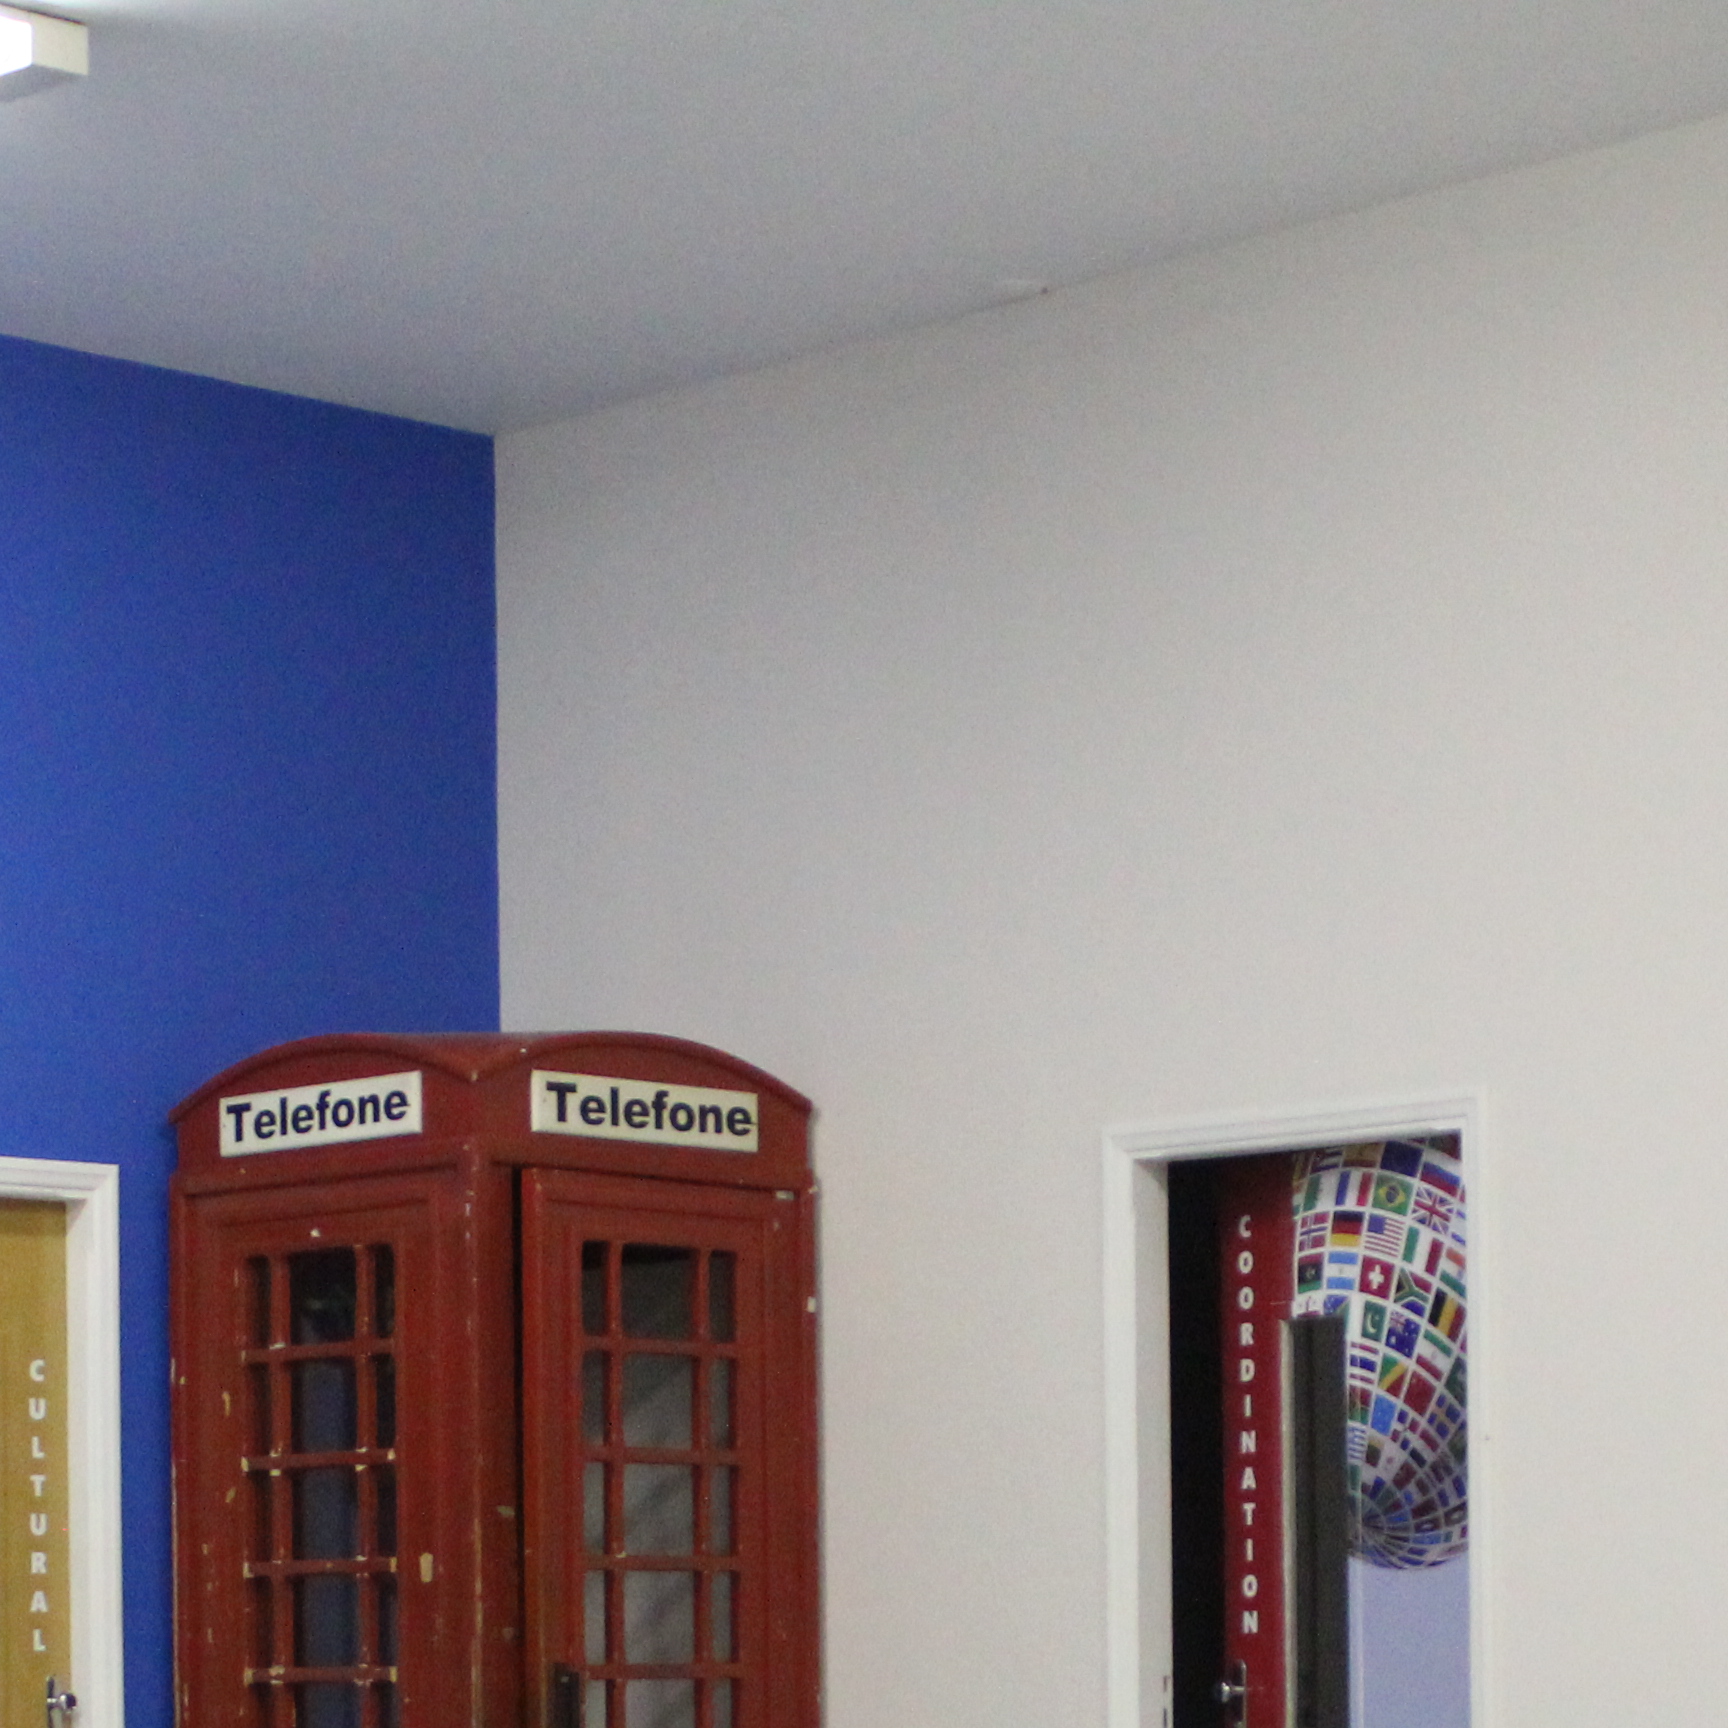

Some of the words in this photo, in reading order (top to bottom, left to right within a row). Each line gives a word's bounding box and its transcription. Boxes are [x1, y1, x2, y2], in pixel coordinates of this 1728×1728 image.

[225, 1082, 410, 1143] Telefone
[545, 1080, 756, 1137] Telefone
[28, 1358, 48, 1652] CULTURAL
[1237, 1214, 1259, 1635] COORDINATION
